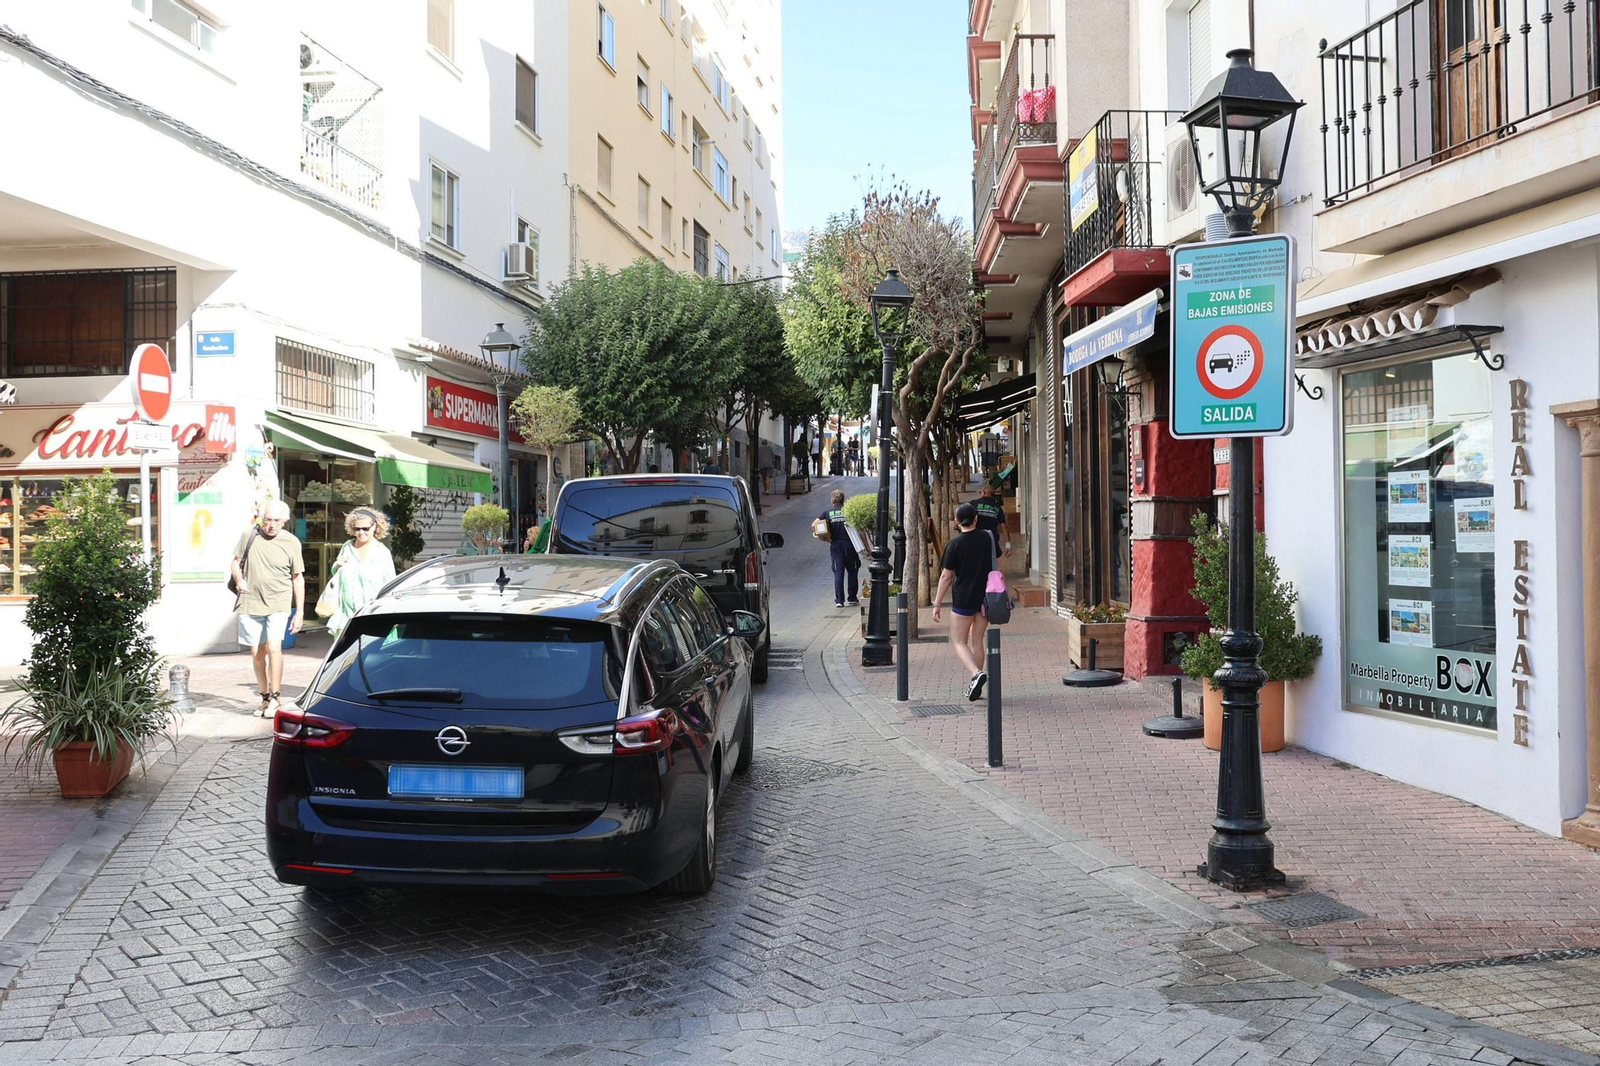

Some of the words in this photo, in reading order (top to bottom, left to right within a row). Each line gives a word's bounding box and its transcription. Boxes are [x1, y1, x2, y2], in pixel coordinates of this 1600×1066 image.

[1188, 304, 1218, 318] BAJAS
[1221, 301, 1273, 316] EMISIONES
[1209, 291, 1236, 301] ZONA
[1239, 288, 1251, 299] DE
[1068, 343, 1088, 366] BODEGA
[1089, 340, 1097, 356] LA
[1097, 327, 1123, 352] VERBENA
[445, 394, 499, 428] SUPERMARK
[1204, 406, 1254, 422] SALIDA
[32, 409, 205, 460] Canto
[208, 411, 236, 449] illy
[1508, 376, 1530, 512] REAL
[1412, 536, 1422, 544] BOX
[1512, 540, 1532, 747] ESTATE
[1350, 661, 1390, 682] Marbella
[1391, 667, 1434, 692] Property
[1436, 655, 1494, 698] BOX
[1358, 688, 1484, 723] INMOBILIARIA
[314, 786, 357, 796] INSIGNIA
